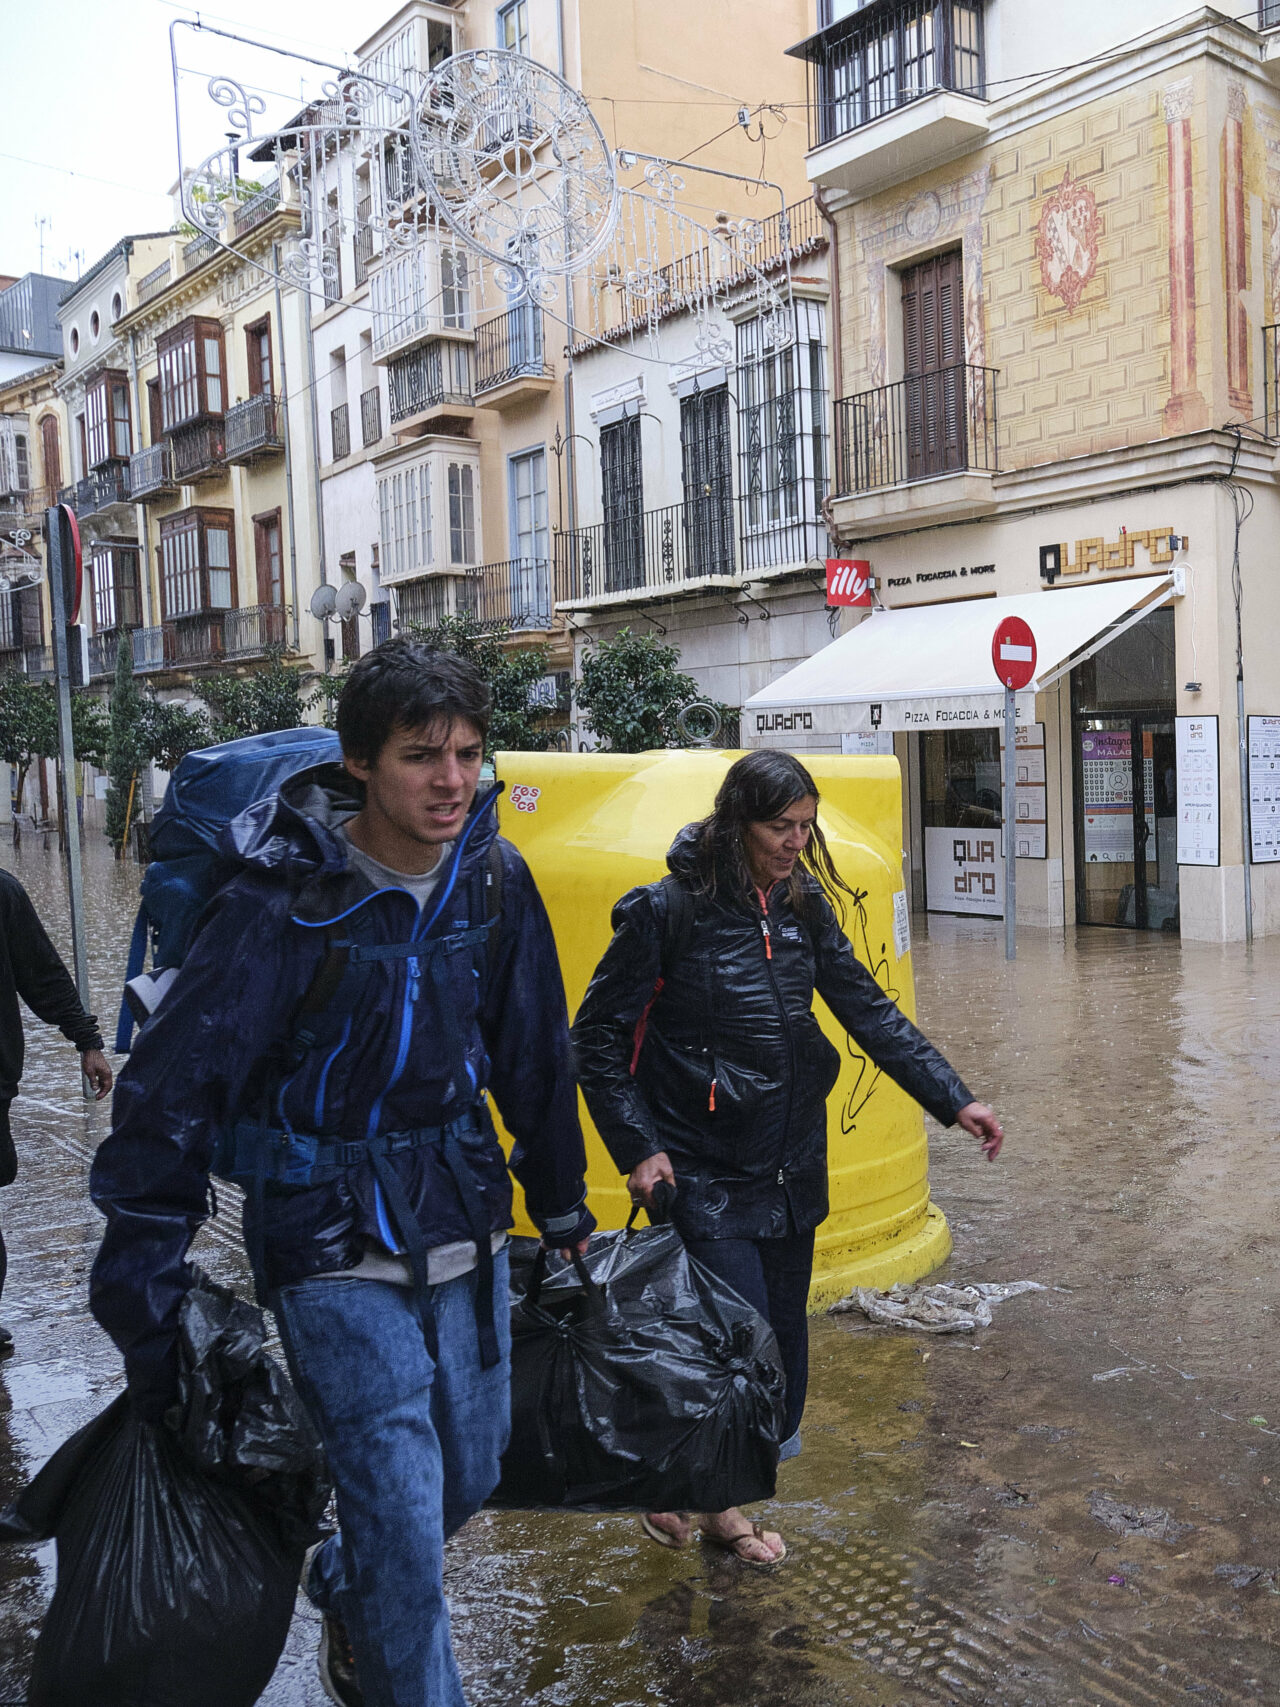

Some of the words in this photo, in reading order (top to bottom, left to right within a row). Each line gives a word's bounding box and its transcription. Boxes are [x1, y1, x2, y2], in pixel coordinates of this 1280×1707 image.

[960, 566, 968, 577] &
[830, 566, 868, 603] illy
[905, 712, 930, 723] PIZZA
[984, 709, 990, 719] &
[994, 708, 1021, 719] MOE
